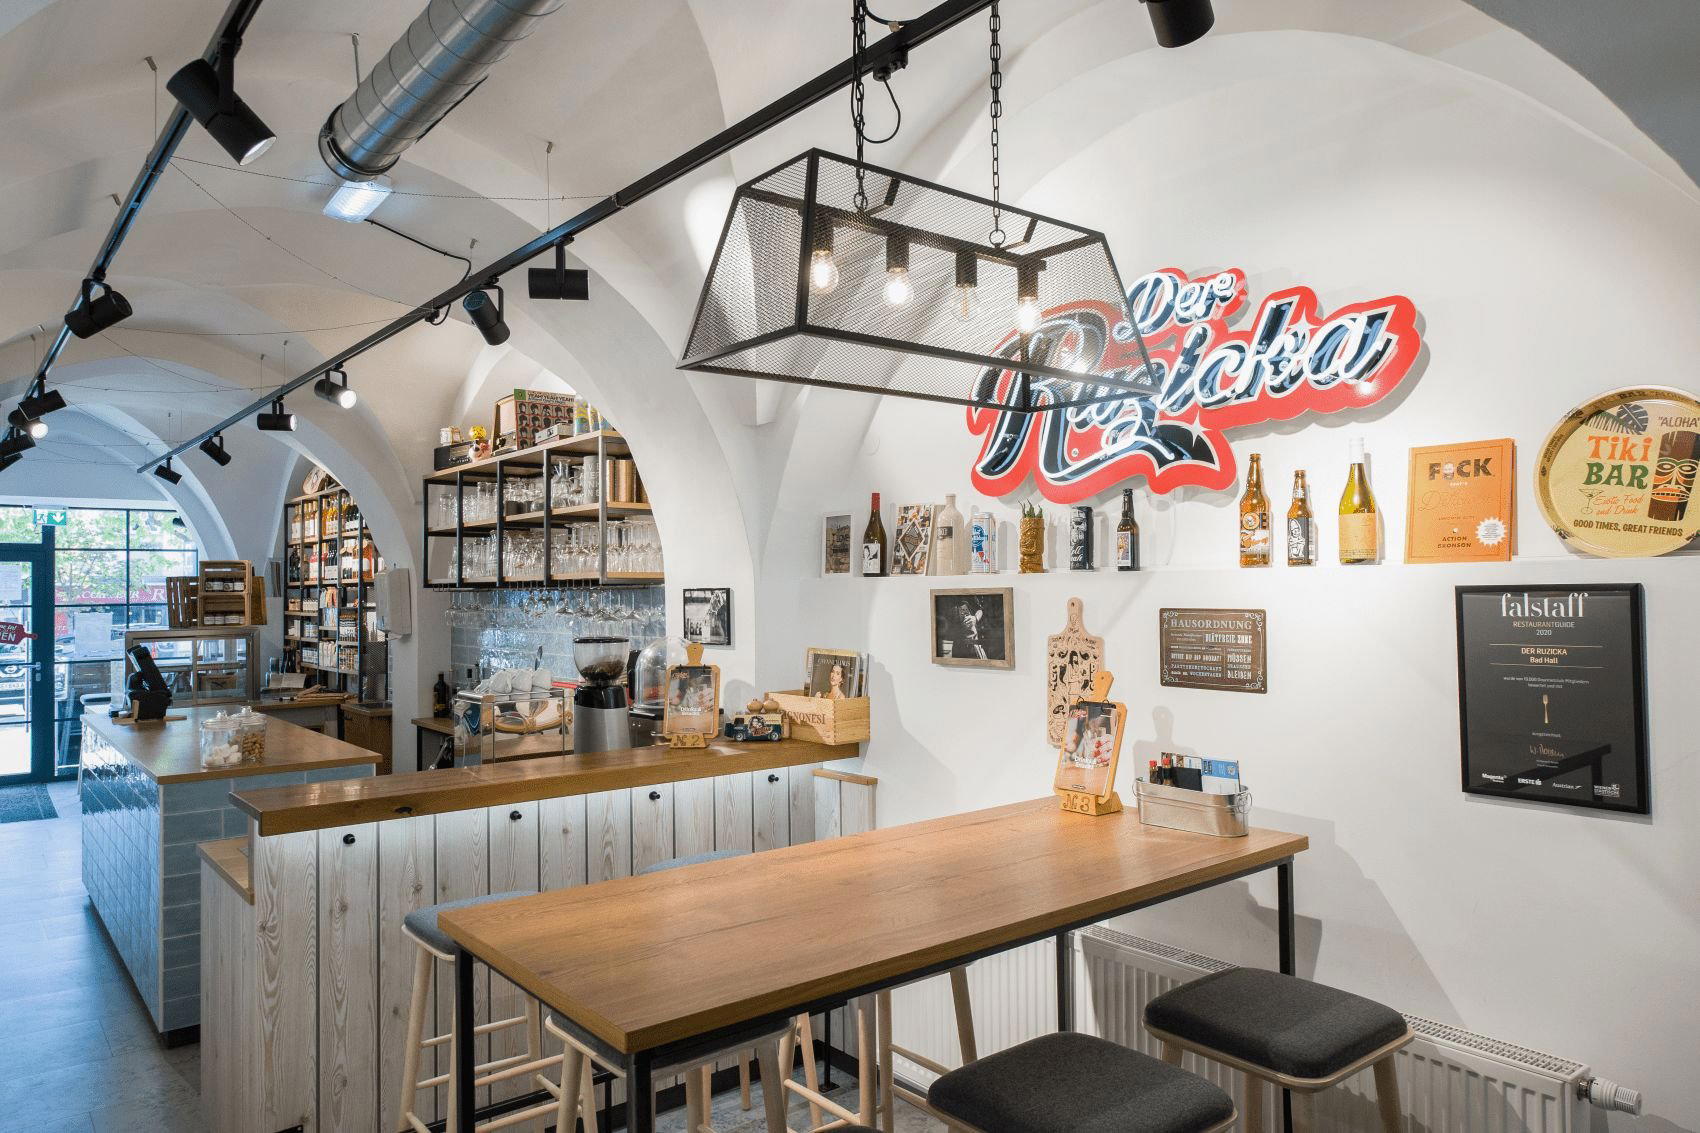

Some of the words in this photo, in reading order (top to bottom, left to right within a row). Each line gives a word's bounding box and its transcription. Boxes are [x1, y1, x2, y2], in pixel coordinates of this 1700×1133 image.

[1113, 270, 1238, 341] Der
[970, 294, 1400, 484] Ruzicka
[1588, 436, 1653, 462] Tiki
[1582, 462, 1649, 490] BAR
[1574, 519, 1594, 529] GOOD
[1595, 521, 1620, 532] TIMES,
[1623, 523, 1647, 534] GREAT
[1649, 525, 1684, 537] FRIENDS
[1501, 592, 1589, 618] falstaff
[1170, 619, 1252, 630] HAUSORDNUNG
[0, 632, 16, 642] EN
[1521, 647, 1535, 655] DER
[1536, 648, 1568, 656] RUZICKA
[1227, 670, 1252, 680] BLEIBEN
[1517, 777, 1535, 785] ERSTE
[1552, 782, 1574, 790] Austrian
[1080, 796, 1090, 812] 3
